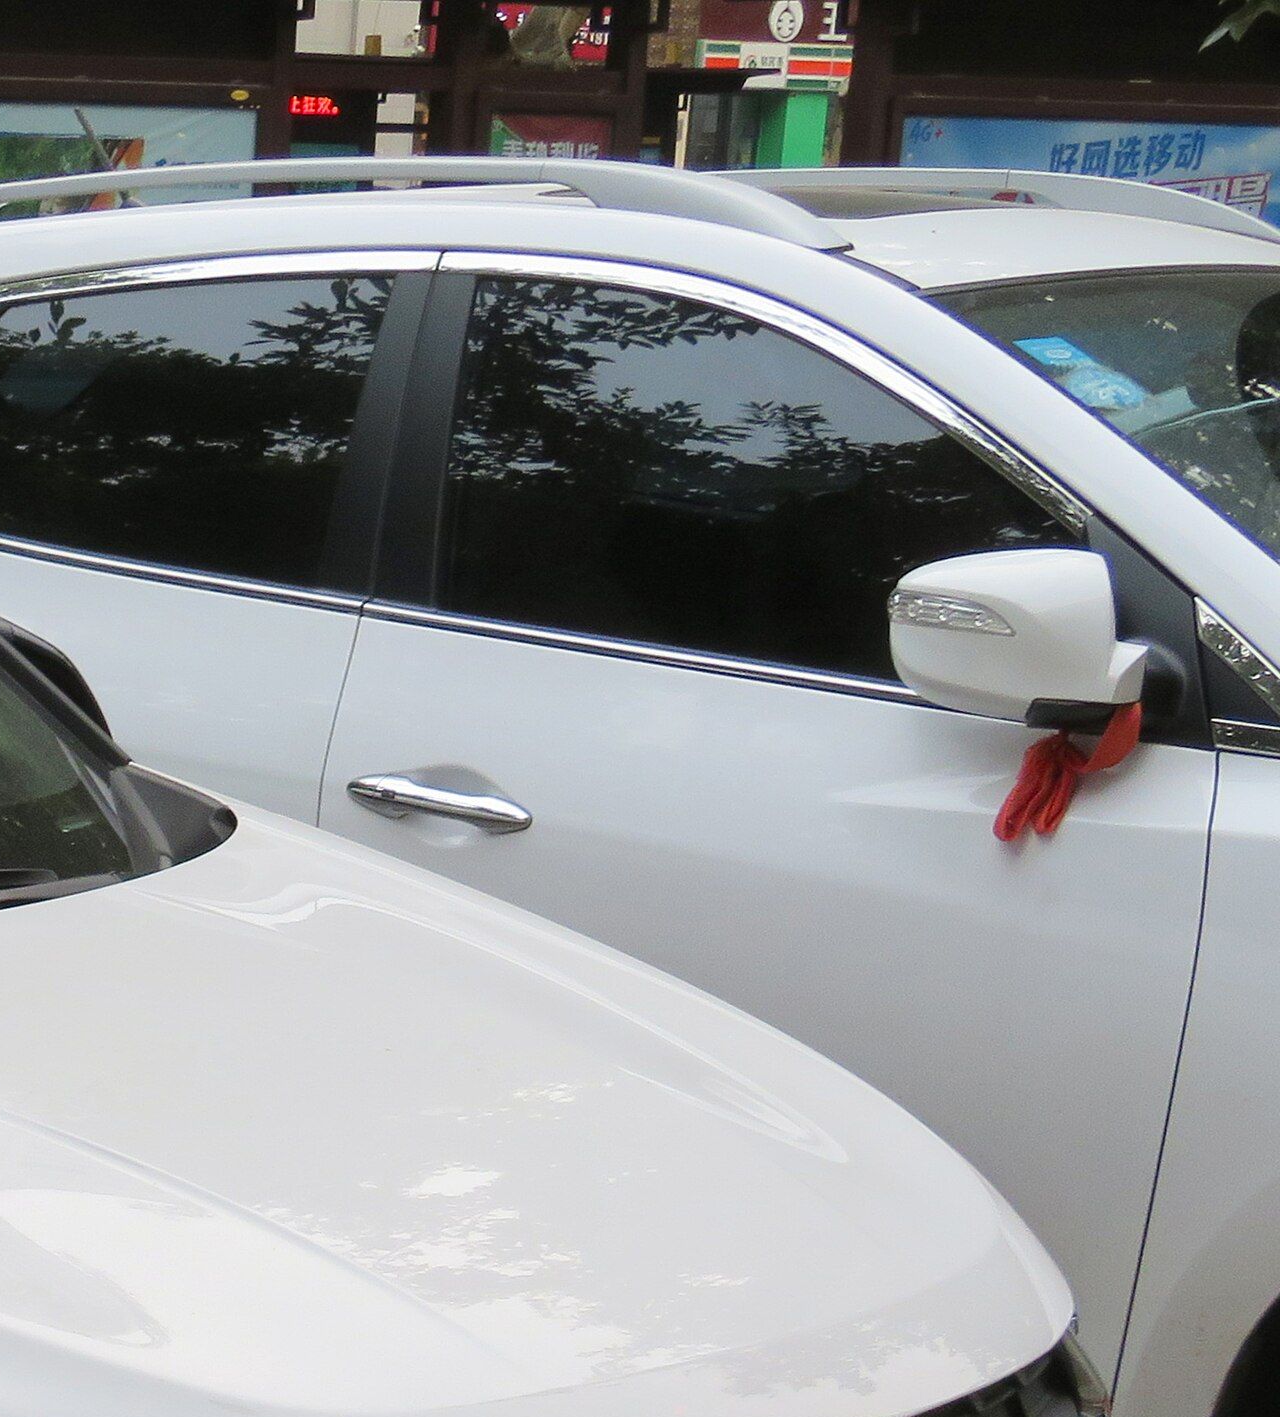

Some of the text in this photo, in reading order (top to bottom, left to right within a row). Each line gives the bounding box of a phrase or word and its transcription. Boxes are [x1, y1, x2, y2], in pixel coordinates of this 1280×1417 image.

[1049, 130, 1206, 177] 好网选移动
